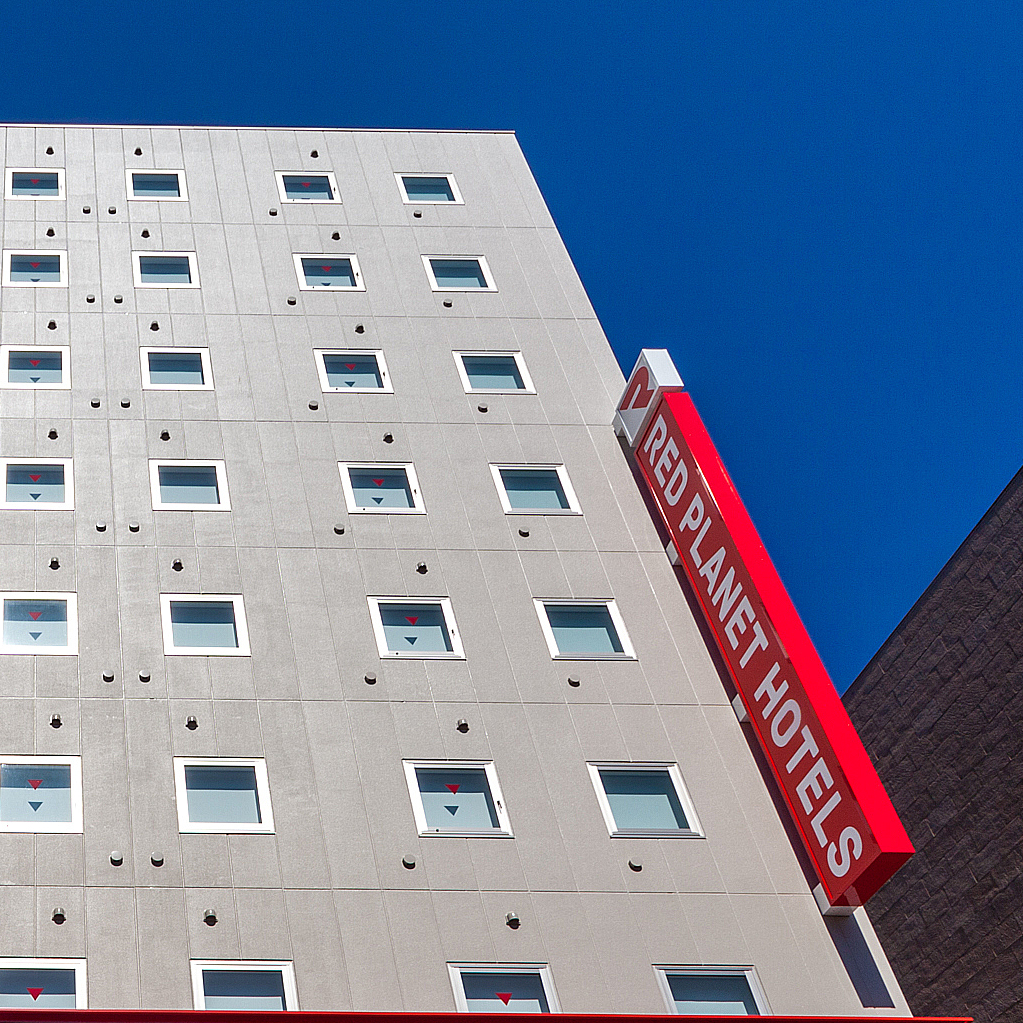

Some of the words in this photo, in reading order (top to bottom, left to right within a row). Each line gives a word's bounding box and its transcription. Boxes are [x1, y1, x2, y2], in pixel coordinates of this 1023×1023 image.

[643, 413, 689, 507] RED
[678, 492, 769, 669] PLANET
[753, 661, 862, 878] HOTELS
